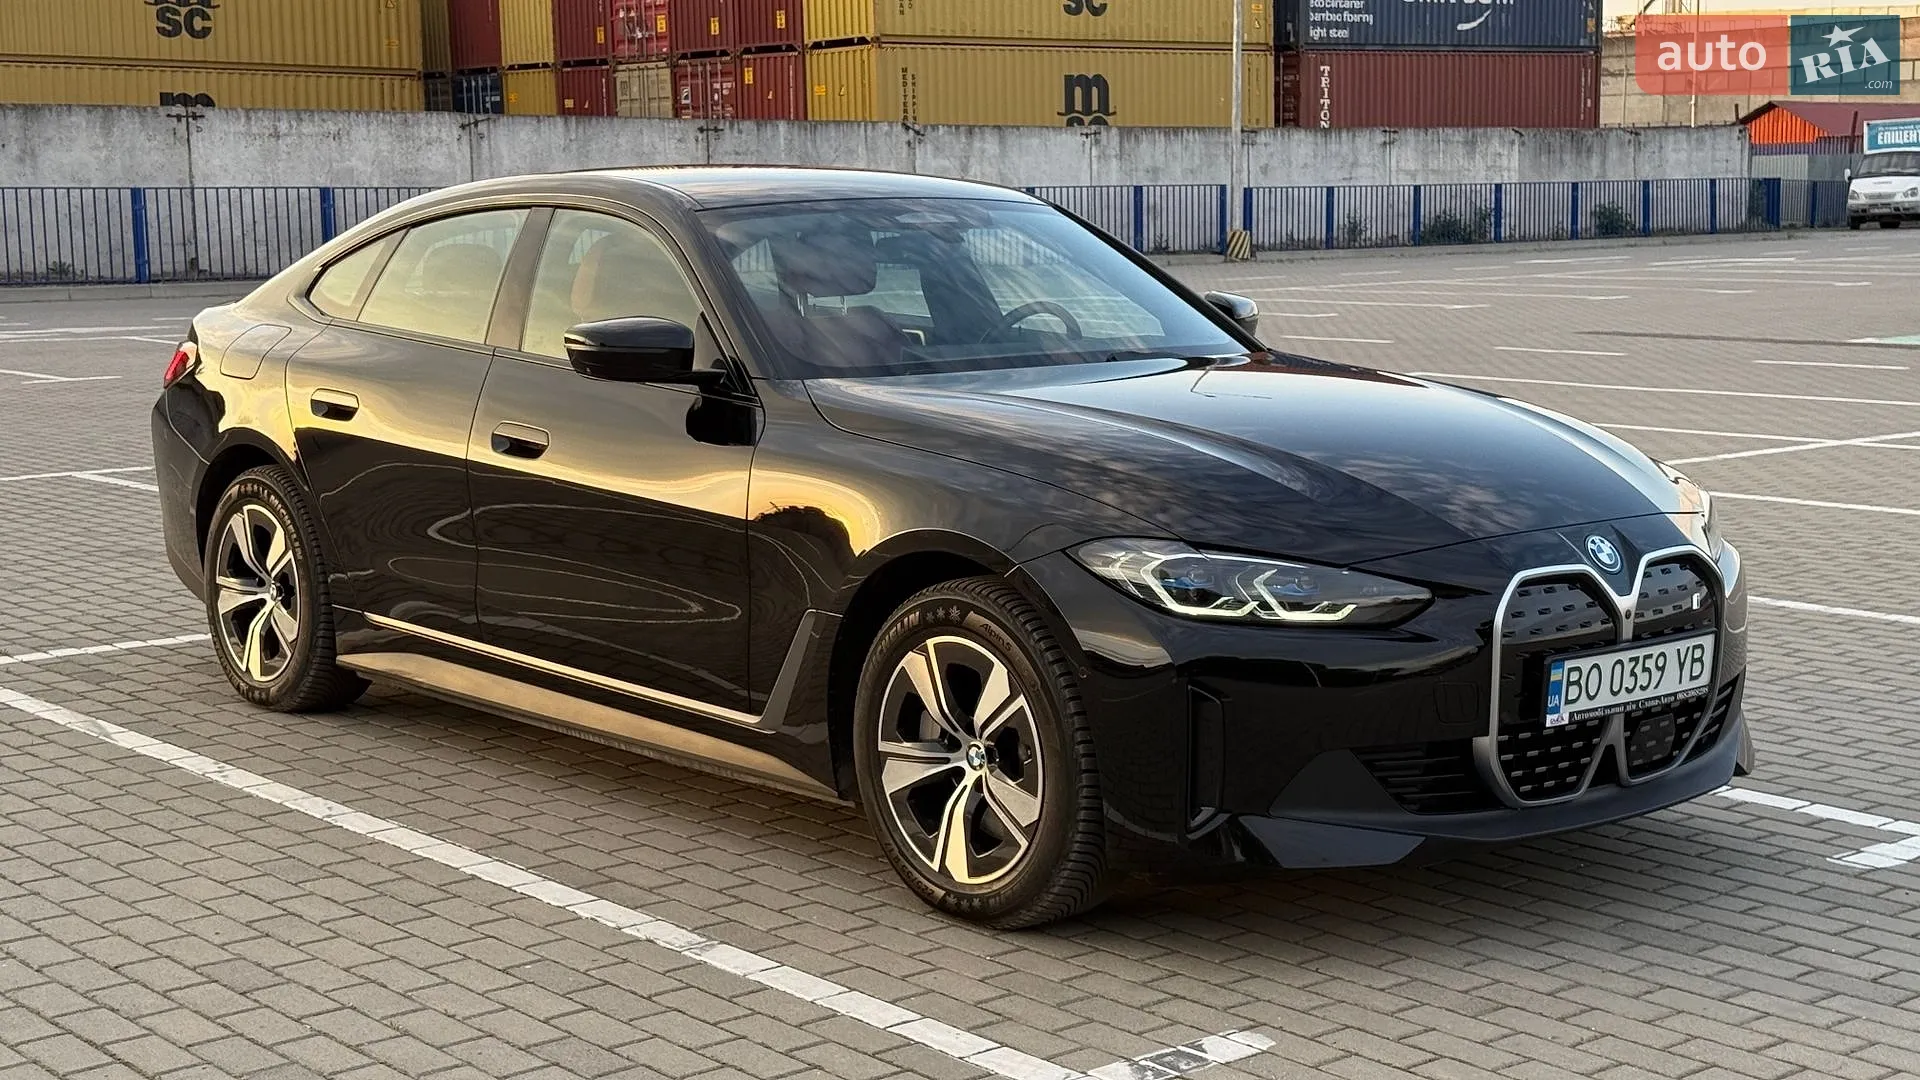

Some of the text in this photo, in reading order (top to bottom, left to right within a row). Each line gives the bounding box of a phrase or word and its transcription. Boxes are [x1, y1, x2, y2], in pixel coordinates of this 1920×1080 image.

[1320, 66, 1330, 128] TRITON
[1547, 695, 1560, 707] UA
[1564, 643, 1706, 705] BO 0359 YB
